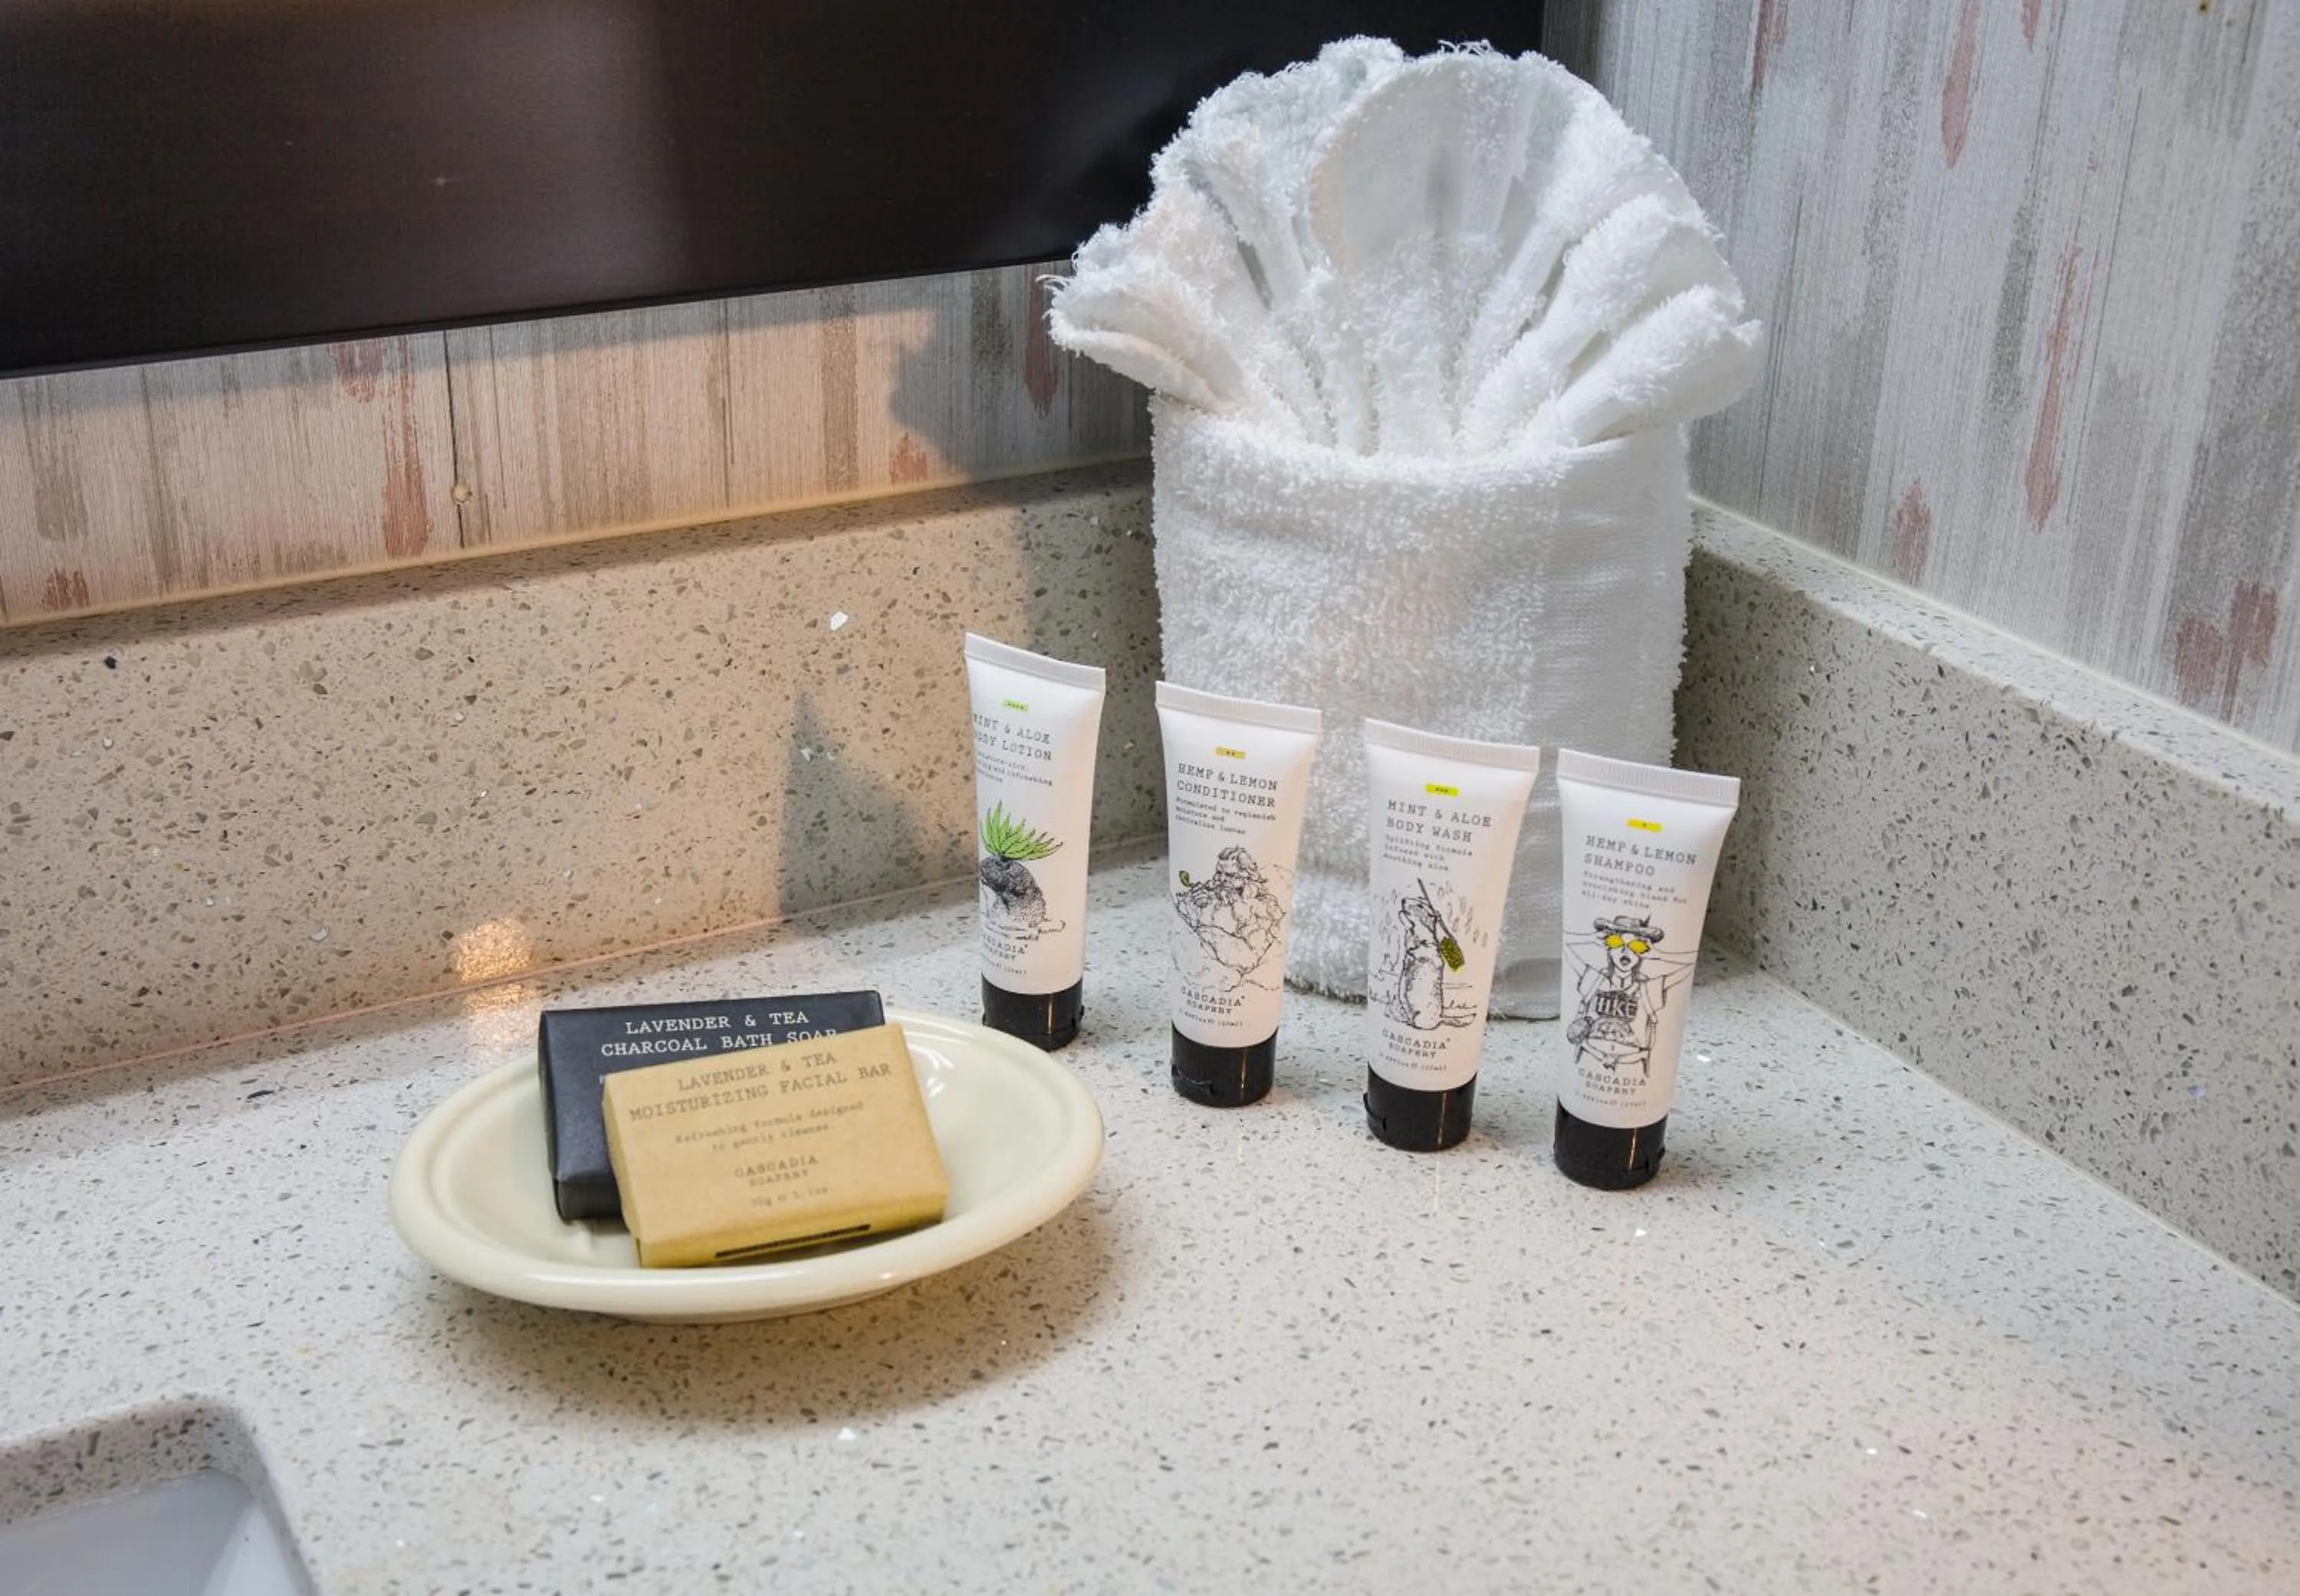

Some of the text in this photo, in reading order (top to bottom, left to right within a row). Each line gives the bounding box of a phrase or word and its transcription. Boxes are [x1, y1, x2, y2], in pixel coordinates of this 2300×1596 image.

[1017, 728, 1051, 744] ALOE
[1002, 740, 1052, 761] LOTION
[1178, 763, 1277, 791] HEMP & LEMON
[1177, 780, 1275, 807] CONDITIONER
[1387, 800, 1491, 827] MINT & ALOE
[1386, 817, 1472, 842] BODY WASH
[1585, 835, 1697, 865] HEMP & LEMON
[1584, 853, 1655, 877] SHAMPOO
[1181, 987, 1242, 1007] CASCADIA
[626, 1011, 810, 1034] LAVENDER & TEA
[601, 1038, 708, 1056] CHARCOAL
[721, 1033, 774, 1049] BATH
[1382, 1029, 1447, 1049] CASCADIA
[678, 1052, 837, 1091] LAVENDER & TEA
[1578, 1068, 1646, 1086] CASCADIA
[629, 1063, 892, 1121] MOISTURIZING FACIAL BAR
[734, 1154, 819, 1178] CASCADIA
